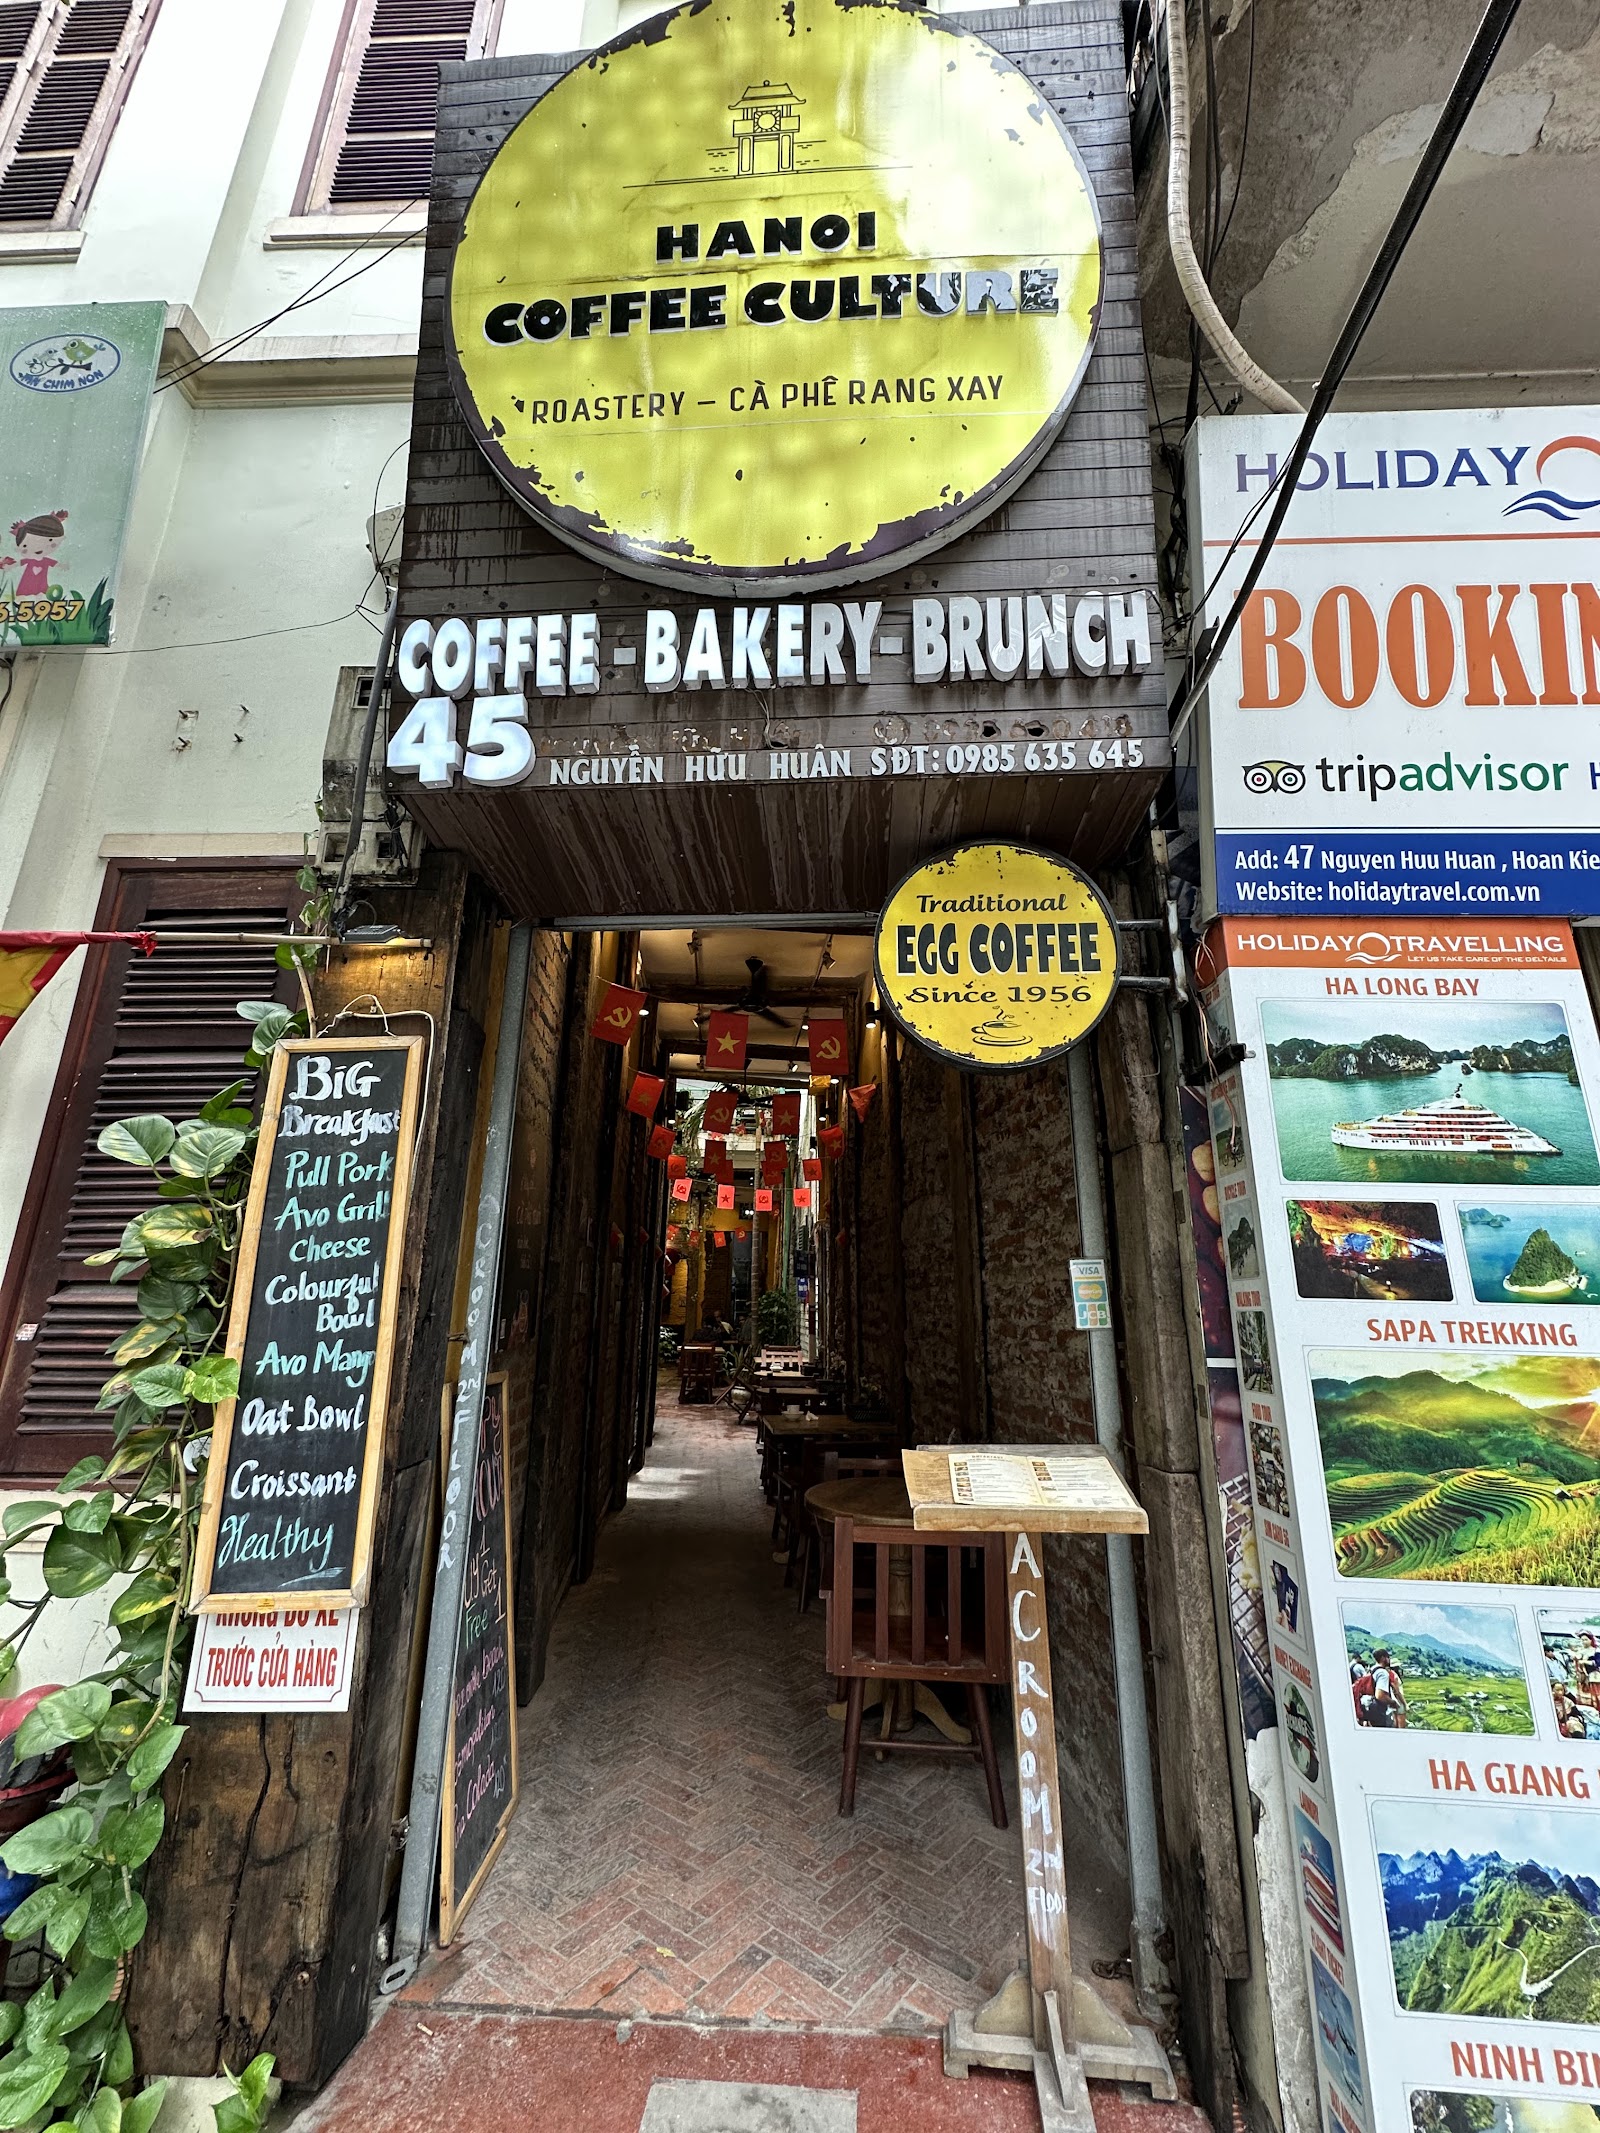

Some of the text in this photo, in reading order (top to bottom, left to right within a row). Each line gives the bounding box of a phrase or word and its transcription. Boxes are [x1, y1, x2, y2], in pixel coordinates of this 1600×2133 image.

[656, 212, 877, 264] HANOI
[483, 267, 1059, 346] COFFEE CULTURE
[532, 391, 685, 424] ROASTERY
[730, 380, 770, 412] CÀ
[781, 375, 839, 409] PHÊ
[848, 377, 936, 406] RANG
[947, 374, 1004, 403] XAY
[1236, 446, 1531, 493] HOLIDAY
[398, 612, 601, 700] COFFEE
[644, 600, 883, 694] BAKERY
[912, 590, 1152, 684] BRUNCH
[386, 694, 536, 789] 45
[769, 743, 851, 780] HUÂN
[1024, 741, 1077, 772] 635
[1088, 739, 1145, 769] 645
[1316, 752, 1569, 802] tripadvisor
[1234, 850, 1280, 871] Add:
[1283, 844, 1315, 870] 47
[1321, 849, 1396, 875] Nguyen
[1400, 850, 1441, 870] Huu
[1444, 850, 1496, 870] Huan
[1512, 849, 1564, 870] Hoan
[916, 894, 1068, 913] Traditional
[1236, 881, 1541, 907] Website: holidaytravel.com.vn
[897, 922, 1102, 976] EGG COFFEE
[1237, 933, 1564, 953] HOLIDAY TRAVELLING
[906, 986, 1092, 1003] Since 1956
[1325, 977, 1480, 997] HA LONG BAY
[278, 1104, 401, 1146] Breakfast
[285, 1150, 394, 1191] Pull Pork
[274, 1190, 391, 1231] Avo Grill
[264, 1261, 380, 1315] Colourful
[1079, 1266, 1100, 1275] VISA
[316, 1299, 375, 1333] Bowl
[1367, 1318, 1578, 1348] SAPA TREKKING
[256, 1341, 307, 1376] Avo
[241, 1394, 365, 1436] Oat Bowl
[231, 1460, 357, 1500] Croissant
[218, 1512, 334, 1573] Healthy
[466, 1603, 488, 1650] Free
[292, 1639, 338, 1687] HÀNG
[1428, 1759, 1591, 1799] HA GIANG
[1451, 2041, 1544, 2084] NINH
